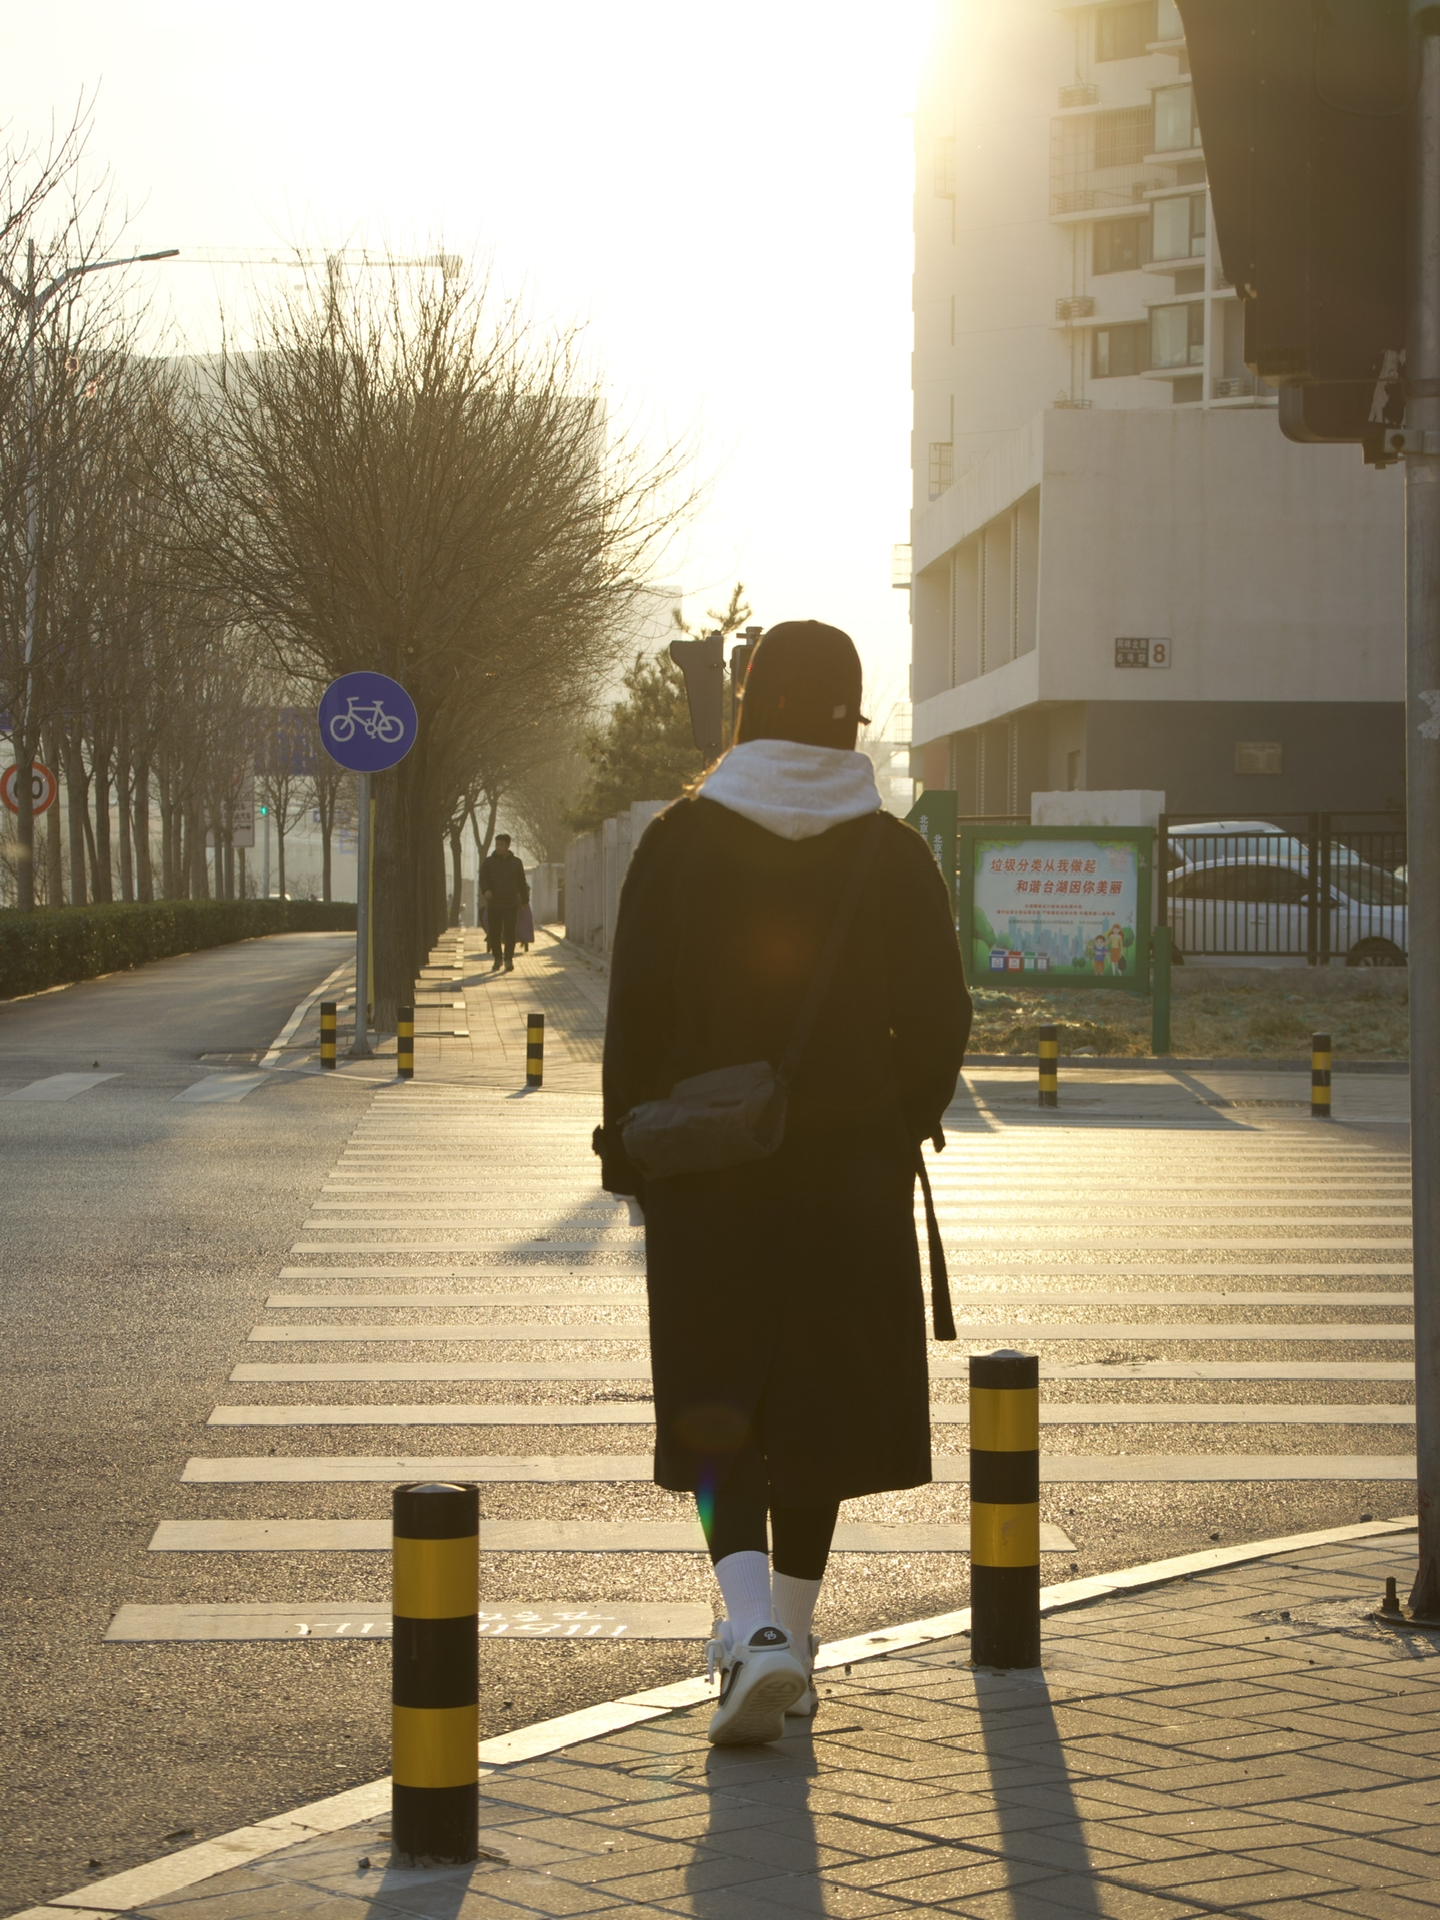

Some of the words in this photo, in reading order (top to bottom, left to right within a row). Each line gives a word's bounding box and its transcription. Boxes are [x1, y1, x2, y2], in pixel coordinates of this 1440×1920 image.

[1153, 643, 1166, 663] 8
[990, 858, 1097, 874] 垃圾分类从我做起
[1016, 879, 1123, 895] 和谐台湖因你美丽
